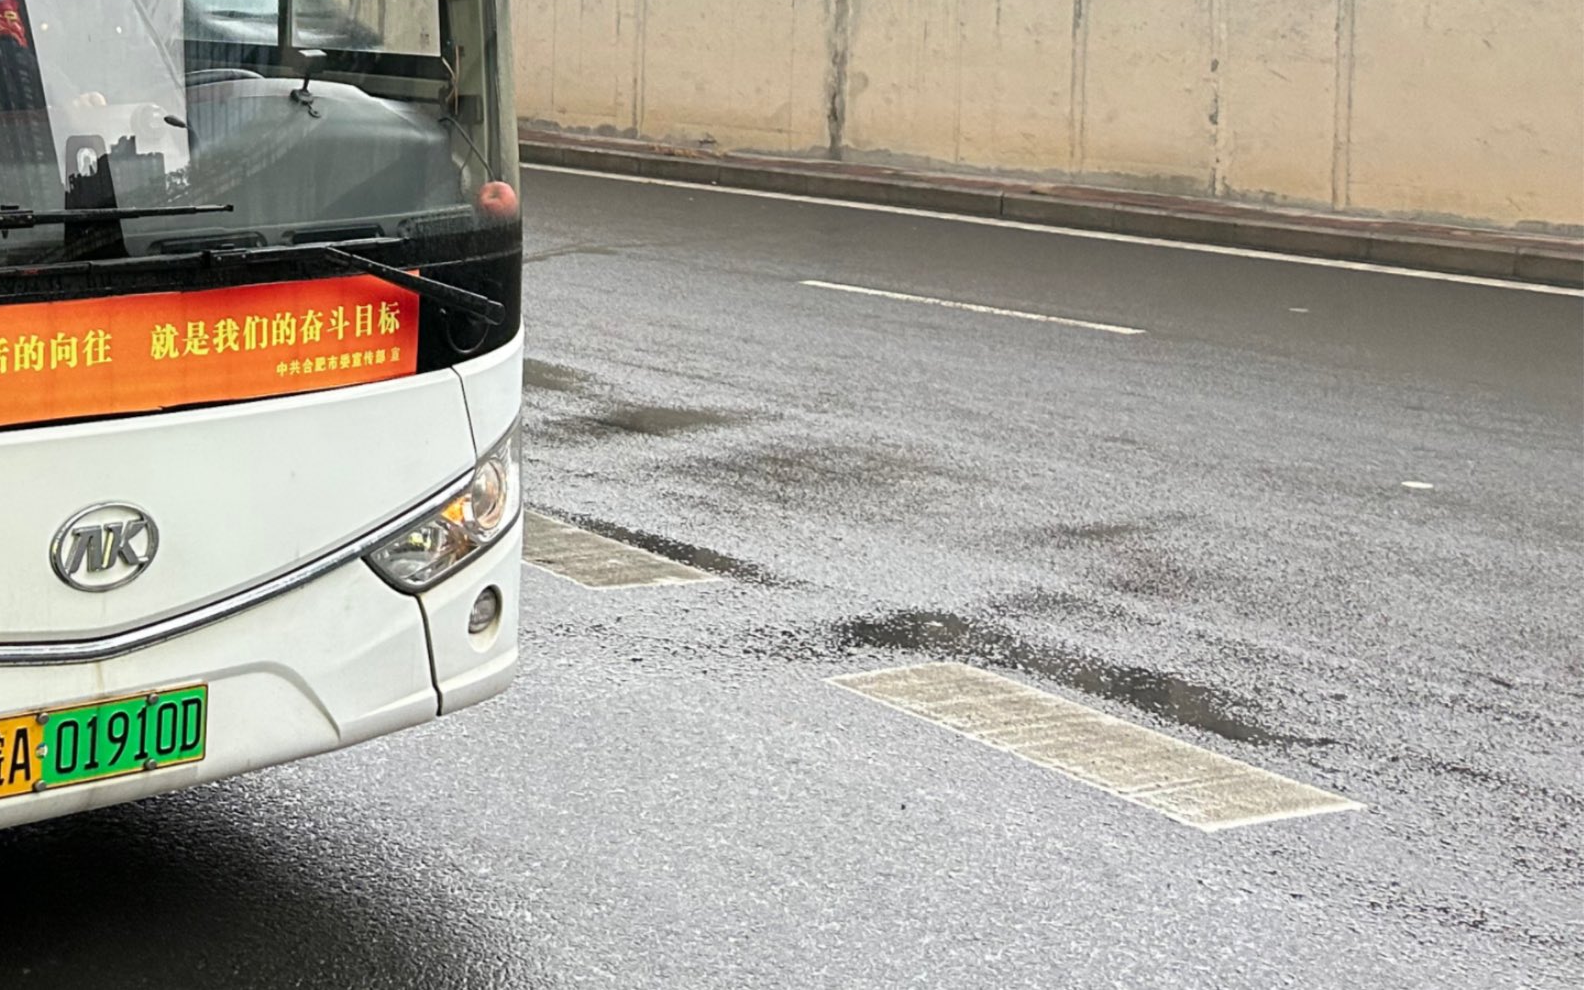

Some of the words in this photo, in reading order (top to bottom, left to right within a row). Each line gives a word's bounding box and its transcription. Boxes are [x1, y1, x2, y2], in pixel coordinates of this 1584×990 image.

[150, 300, 401, 361] 就是我们的奋斗目标
